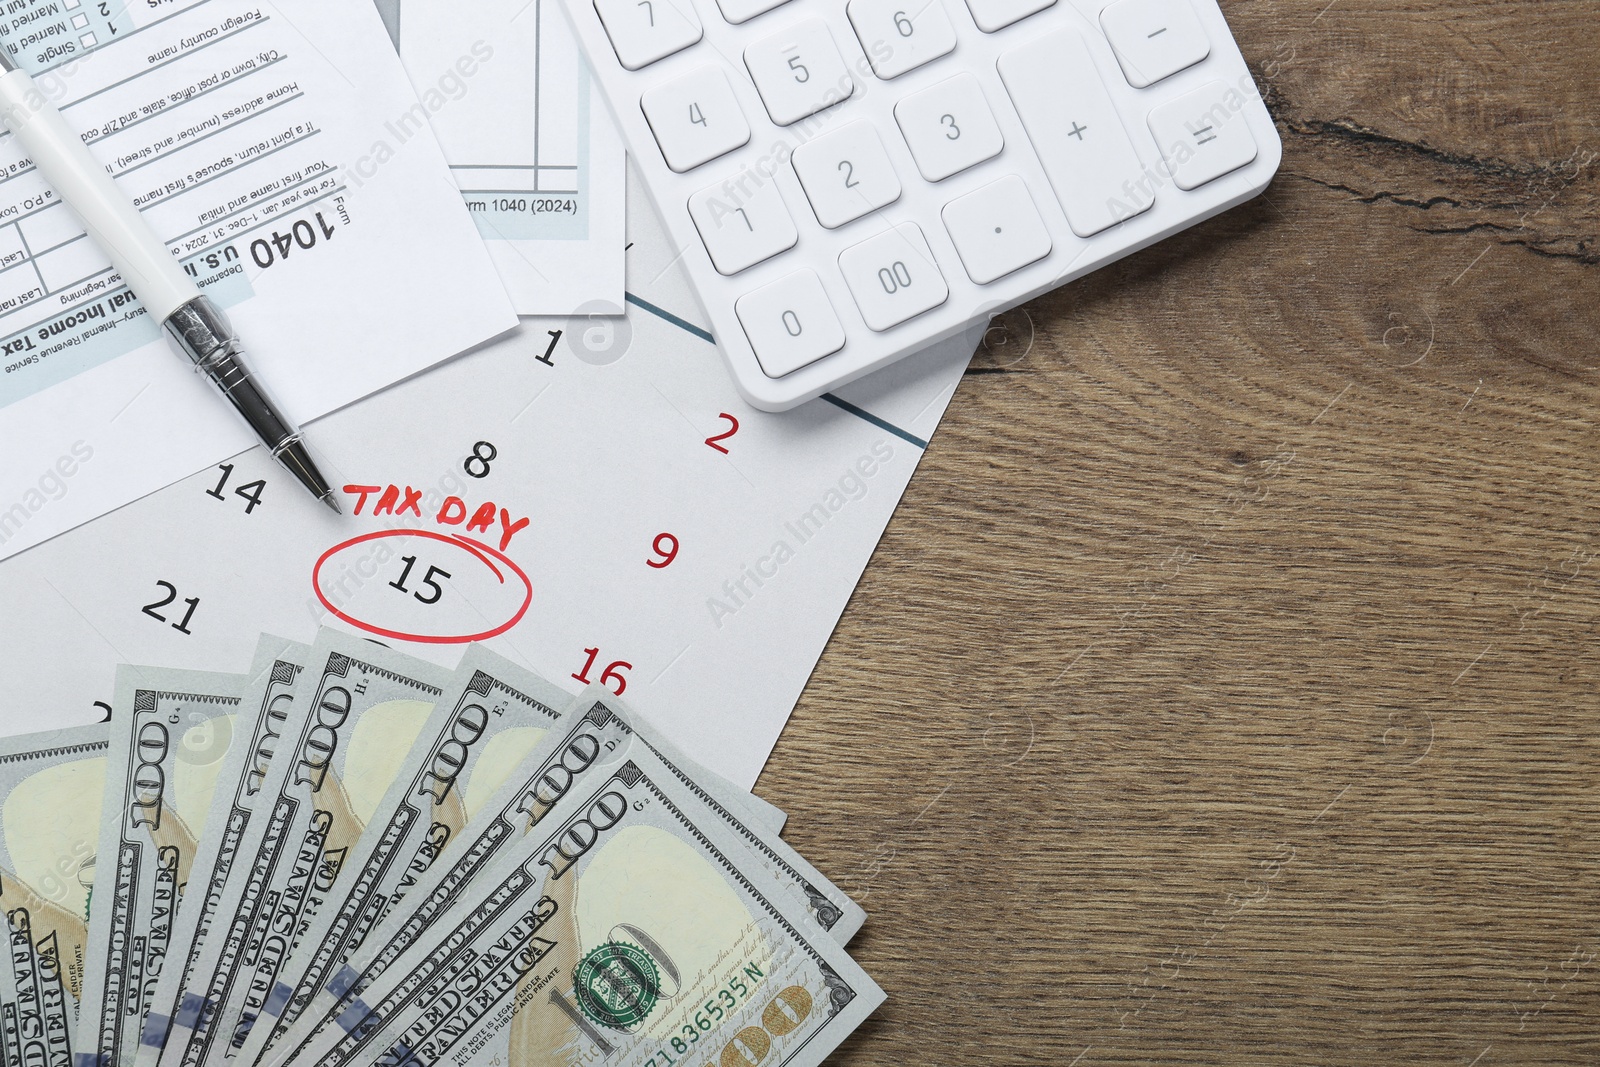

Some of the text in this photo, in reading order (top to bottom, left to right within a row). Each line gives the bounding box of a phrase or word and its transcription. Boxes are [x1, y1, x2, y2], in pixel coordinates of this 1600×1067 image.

[14, 3, 59, 27] Married
[98, 1, 111, 17] 2
[892, 10, 915, 38] 6
[22, 22, 68, 46] Married
[37, 21, 117, 65] 1 Single
[147, 8, 263, 64] Foreign country name
[231, 58, 257, 75] town
[255, 49, 279, 64] City,
[787, 54, 811, 84] 5
[197, 73, 220, 92] post
[220, 70, 231, 82] or
[139, 98, 167, 115] state,
[167, 85, 197, 103] office,
[101, 119, 119, 137] ZIP
[115, 81, 300, 168] Home address (number and street).
[119, 109, 138, 128] and
[687, 102, 708, 128] 4
[939, 113, 961, 141] 3
[9, 162, 18, 172] a
[133, 121, 315, 207] If a joint return, spouse's first name
[837, 160, 861, 189] 2
[44, 190, 53, 200] a
[198, 160, 330, 226] Your first name and initial
[281, 191, 303, 208] year
[303, 184, 319, 198] the
[319, 177, 336, 192] For
[19, 194, 45, 211] P.O.
[259, 202, 280, 216] Jan.
[332, 196, 352, 227] Form
[492, 198, 579, 216] 1040 (2024)
[208, 227, 226, 240] 31,
[734, 207, 754, 233] 1
[181, 234, 210, 252] 2024,
[249, 211, 336, 269] 1040
[199, 245, 240, 270] U.S.
[59, 279, 107, 305] beginning
[877, 260, 913, 296] 00
[16, 287, 43, 304] Last
[37, 303, 107, 341] Income
[781, 309, 803, 338] 0
[0, 334, 37, 357] Tax
[4, 335, 82, 375] Revenue Service
[534, 329, 563, 367] 1
[704, 412, 740, 455] 2
[463, 440, 498, 479] 8
[204, 463, 269, 516] 14
[342, 484, 531, 552] TAX DAY
[645, 532, 681, 570] 9
[387, 555, 453, 606] 15
[140, 580, 203, 636] 21
[570, 646, 634, 697] 16
[293, 685, 352, 793] 100
[417, 703, 489, 806] 100
[130, 721, 170, 832] 100
[516, 733, 601, 826] 100
[538, 790, 627, 881] 100
[238, 801, 291, 920] DOLLARS
[270, 807, 334, 937] STATES
[343, 808, 413, 918] DOLLARS
[420, 822, 505, 919] DOLLARS
[107, 847, 138, 970] DOLLARS
[339, 960, 438, 1053] HUNDRED
[430, 872, 529, 966] DOLLARS
[451, 893, 563, 999] STATES
[7, 906, 44, 1040] STATES
[626, 950, 655, 984] TREASURY
[742, 960, 766, 985] N
[424, 928, 560, 1057] AMERICA
[450, 974, 543, 1064] THIS NOTE IS LEGAL TENDER
[456, 966, 561, 1067] ALL DEBTS, PUBLIC AND PRIVATE
